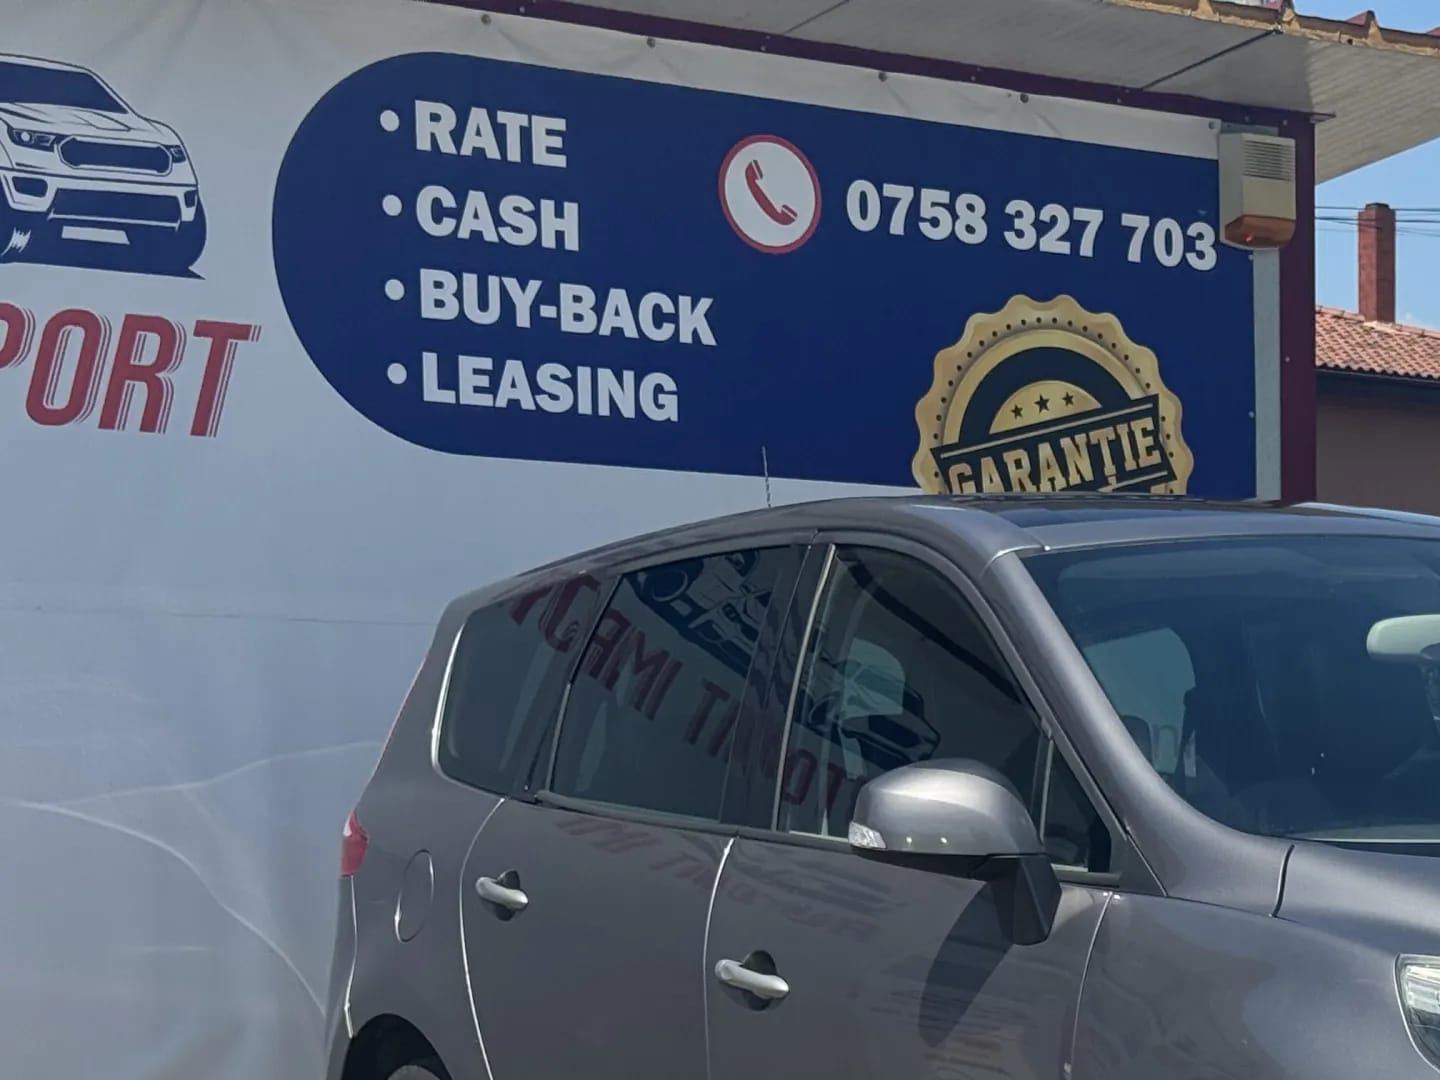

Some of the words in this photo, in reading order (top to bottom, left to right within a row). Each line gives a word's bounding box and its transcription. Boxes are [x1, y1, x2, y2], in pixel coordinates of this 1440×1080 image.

[414, 99, 568, 169] RATE
[415, 185, 580, 253] CASH
[845, 178, 989, 246] 0758
[1003, 199, 1104, 259] 327
[1119, 212, 1219, 273] 703
[419, 267, 718, 347] BUY-BACK
[421, 351, 680, 424] LEASING
